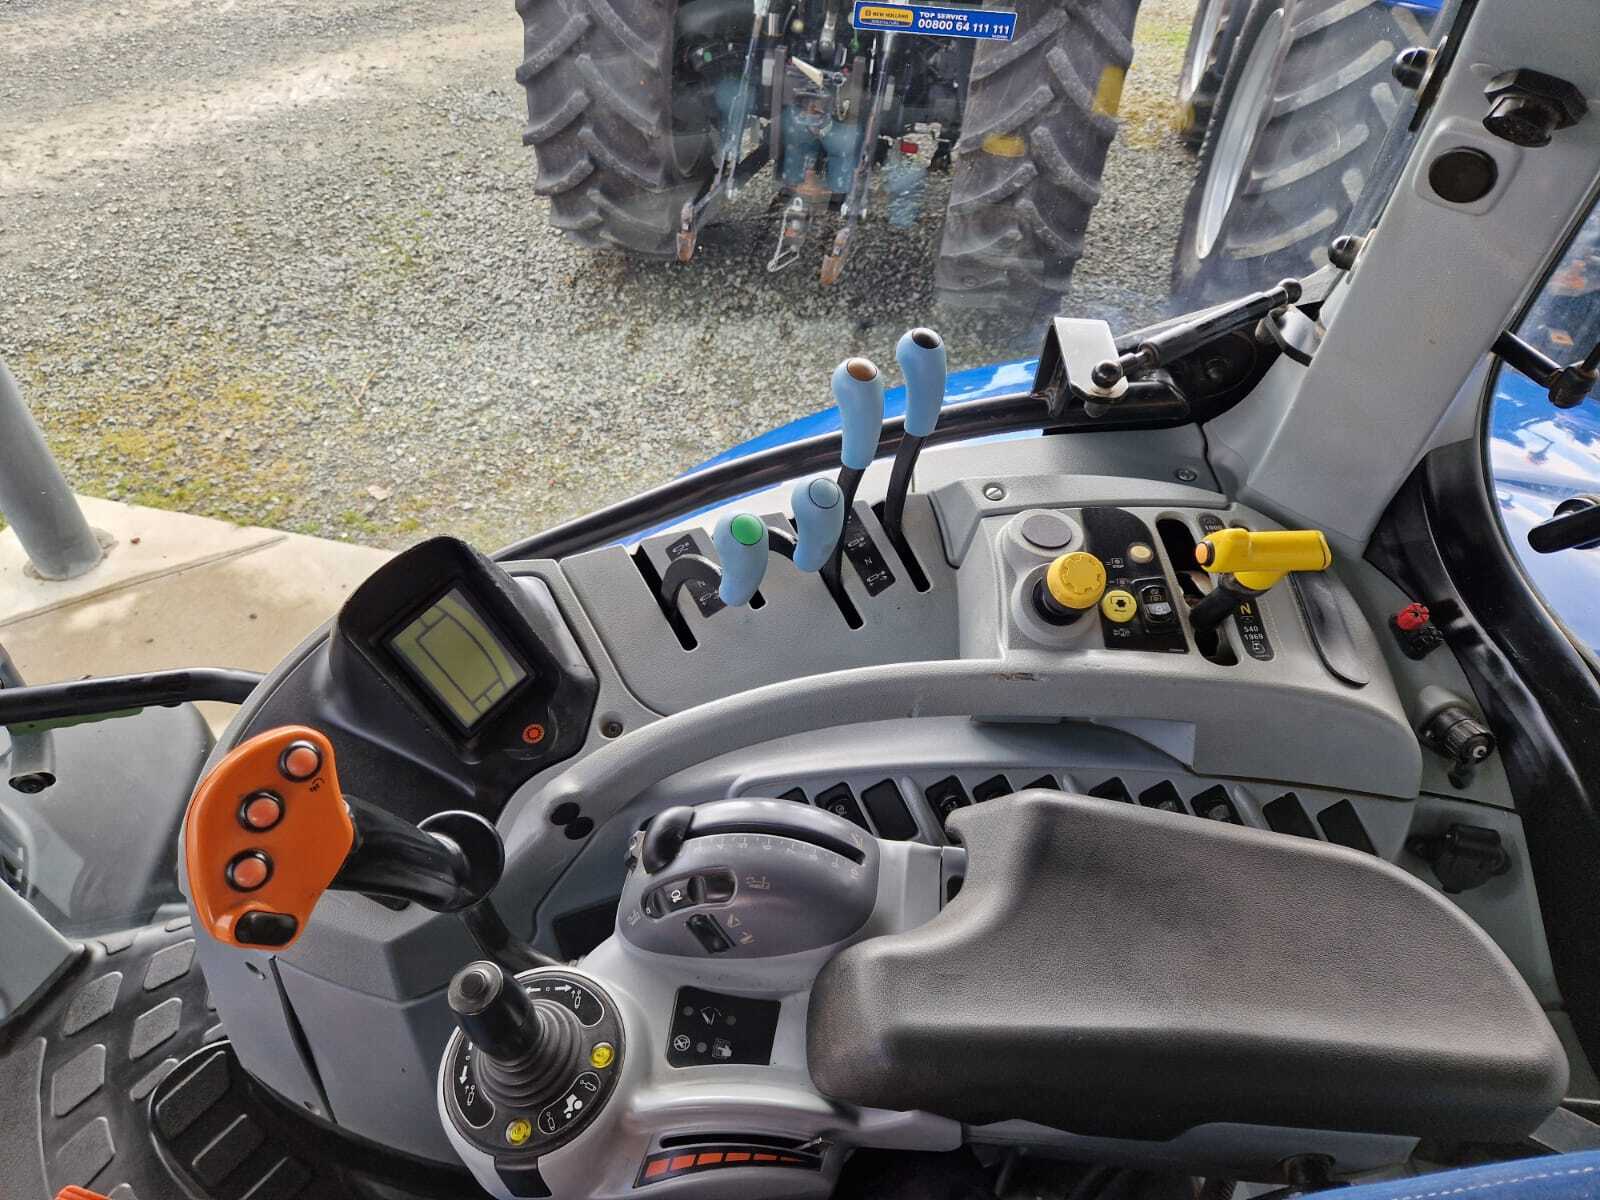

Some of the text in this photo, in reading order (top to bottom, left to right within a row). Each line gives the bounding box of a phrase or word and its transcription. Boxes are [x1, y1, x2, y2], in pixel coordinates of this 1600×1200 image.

[919, 11, 968, 21] TOP SERVICE
[918, 19, 1009, 34] 00800 64 111 111
[1240, 602, 1252, 615] N
